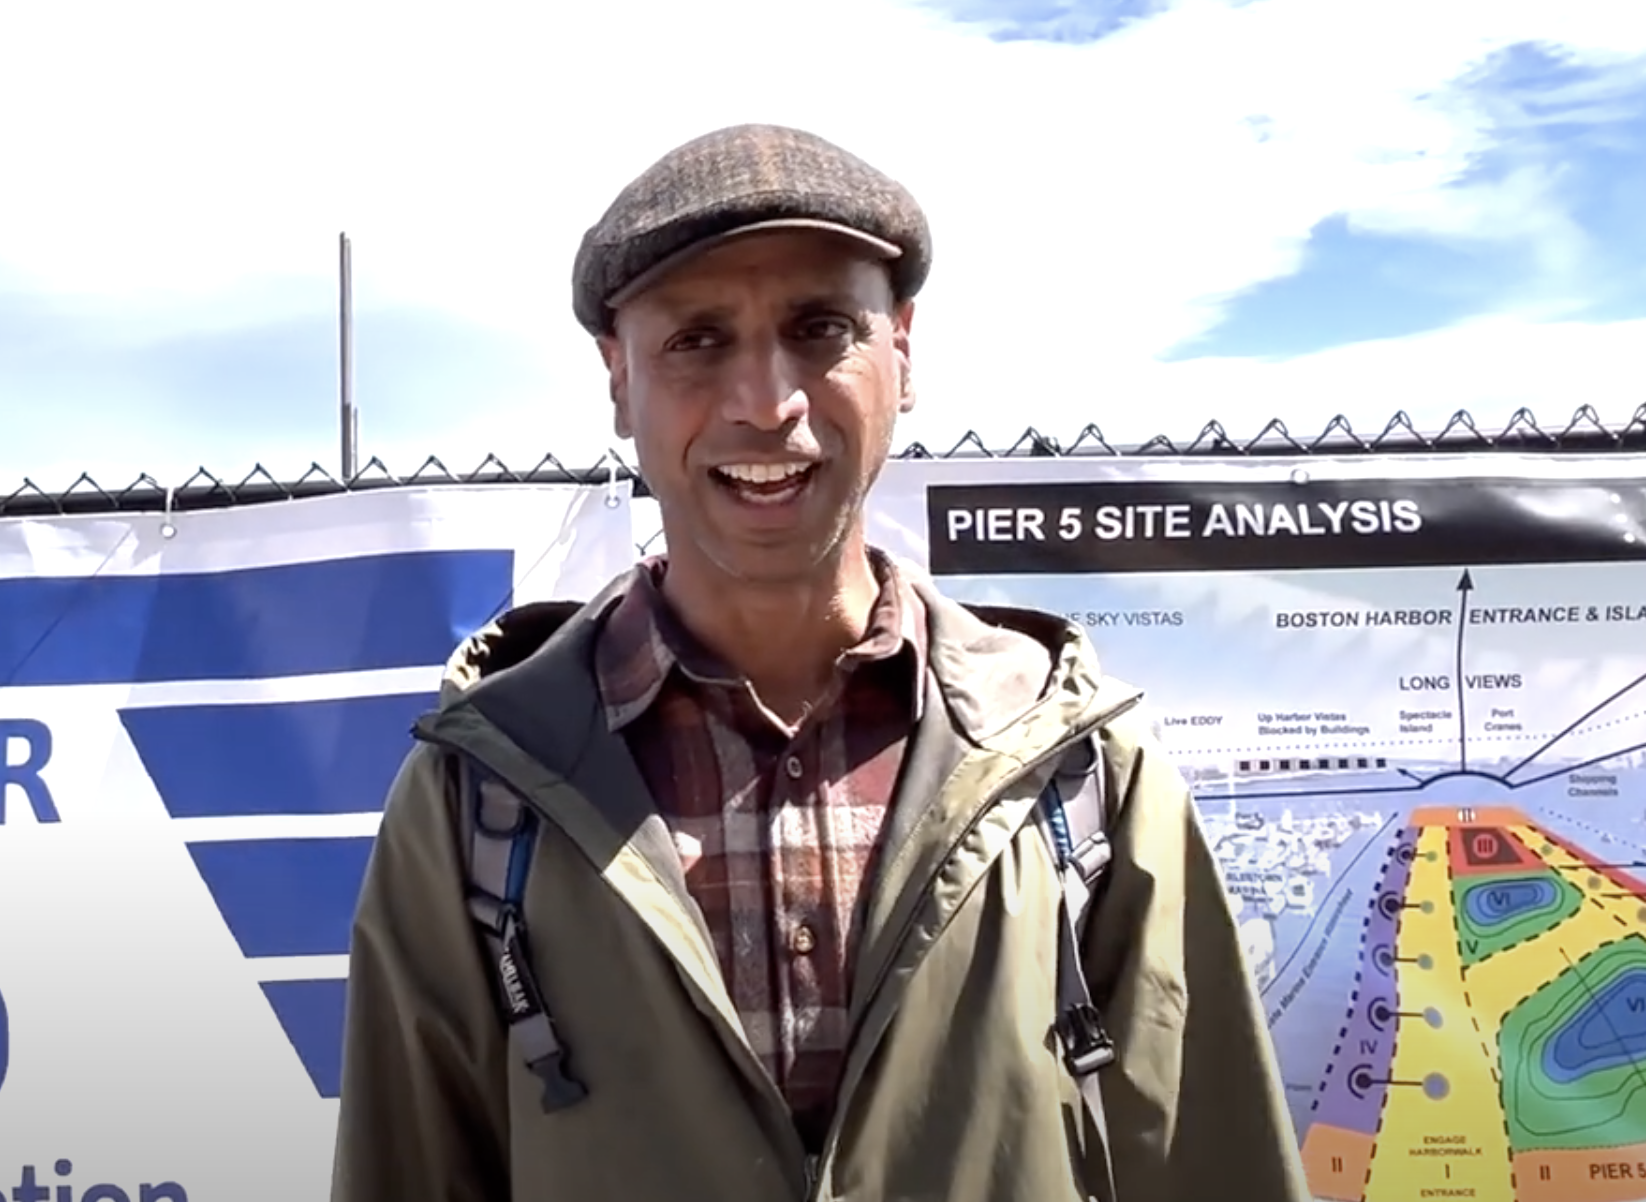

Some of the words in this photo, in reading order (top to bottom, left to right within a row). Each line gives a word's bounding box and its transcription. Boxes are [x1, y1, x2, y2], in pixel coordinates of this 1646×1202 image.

[947, 510, 1045, 541] PIER
[1058, 508, 1082, 540] 5
[1094, 506, 1192, 539] SITE
[1202, 500, 1422, 537] ANALYSIS
[1086, 611, 1120, 627] SKY
[1123, 610, 1184, 626] VISTAS
[1275, 611, 1359, 628] BOSTON
[1365, 609, 1452, 626] HARBOR
[1469, 606, 1580, 624] ENTRANCE
[1585, 606, 1599, 622] &
[1399, 675, 1450, 691] LONG
[1465, 674, 1522, 690] VIEWS
[1258, 713, 1273, 723] Up
[1275, 712, 1312, 722] Harbor
[1314, 712, 1347, 722] Vistas
[1399, 710, 1452, 722] Spectacle
[1491, 708, 1514, 718] Port
[1164, 717, 1188, 726] Live
[1190, 716, 1223, 726] EDDY
[1484, 721, 1522, 732] Cranes
[1258, 726, 1302, 736] Blocked
[1305, 726, 1317, 737] by
[1320, 725, 1370, 737] Buildings
[1399, 723, 1433, 733] Island
[1476, 838, 1493, 853] III
[1465, 939, 1479, 954] V
[1360, 1040, 1378, 1054] IV
[1423, 1135, 1466, 1144] ENGAGE
[1409, 1147, 1482, 1156] HARBORWALK
[1331, 1157, 1343, 1173] II
[1590, 1163, 1634, 1179] PIER
[1539, 1165, 1551, 1181] II
[1420, 1188, 1476, 1197] ENTRANCE
